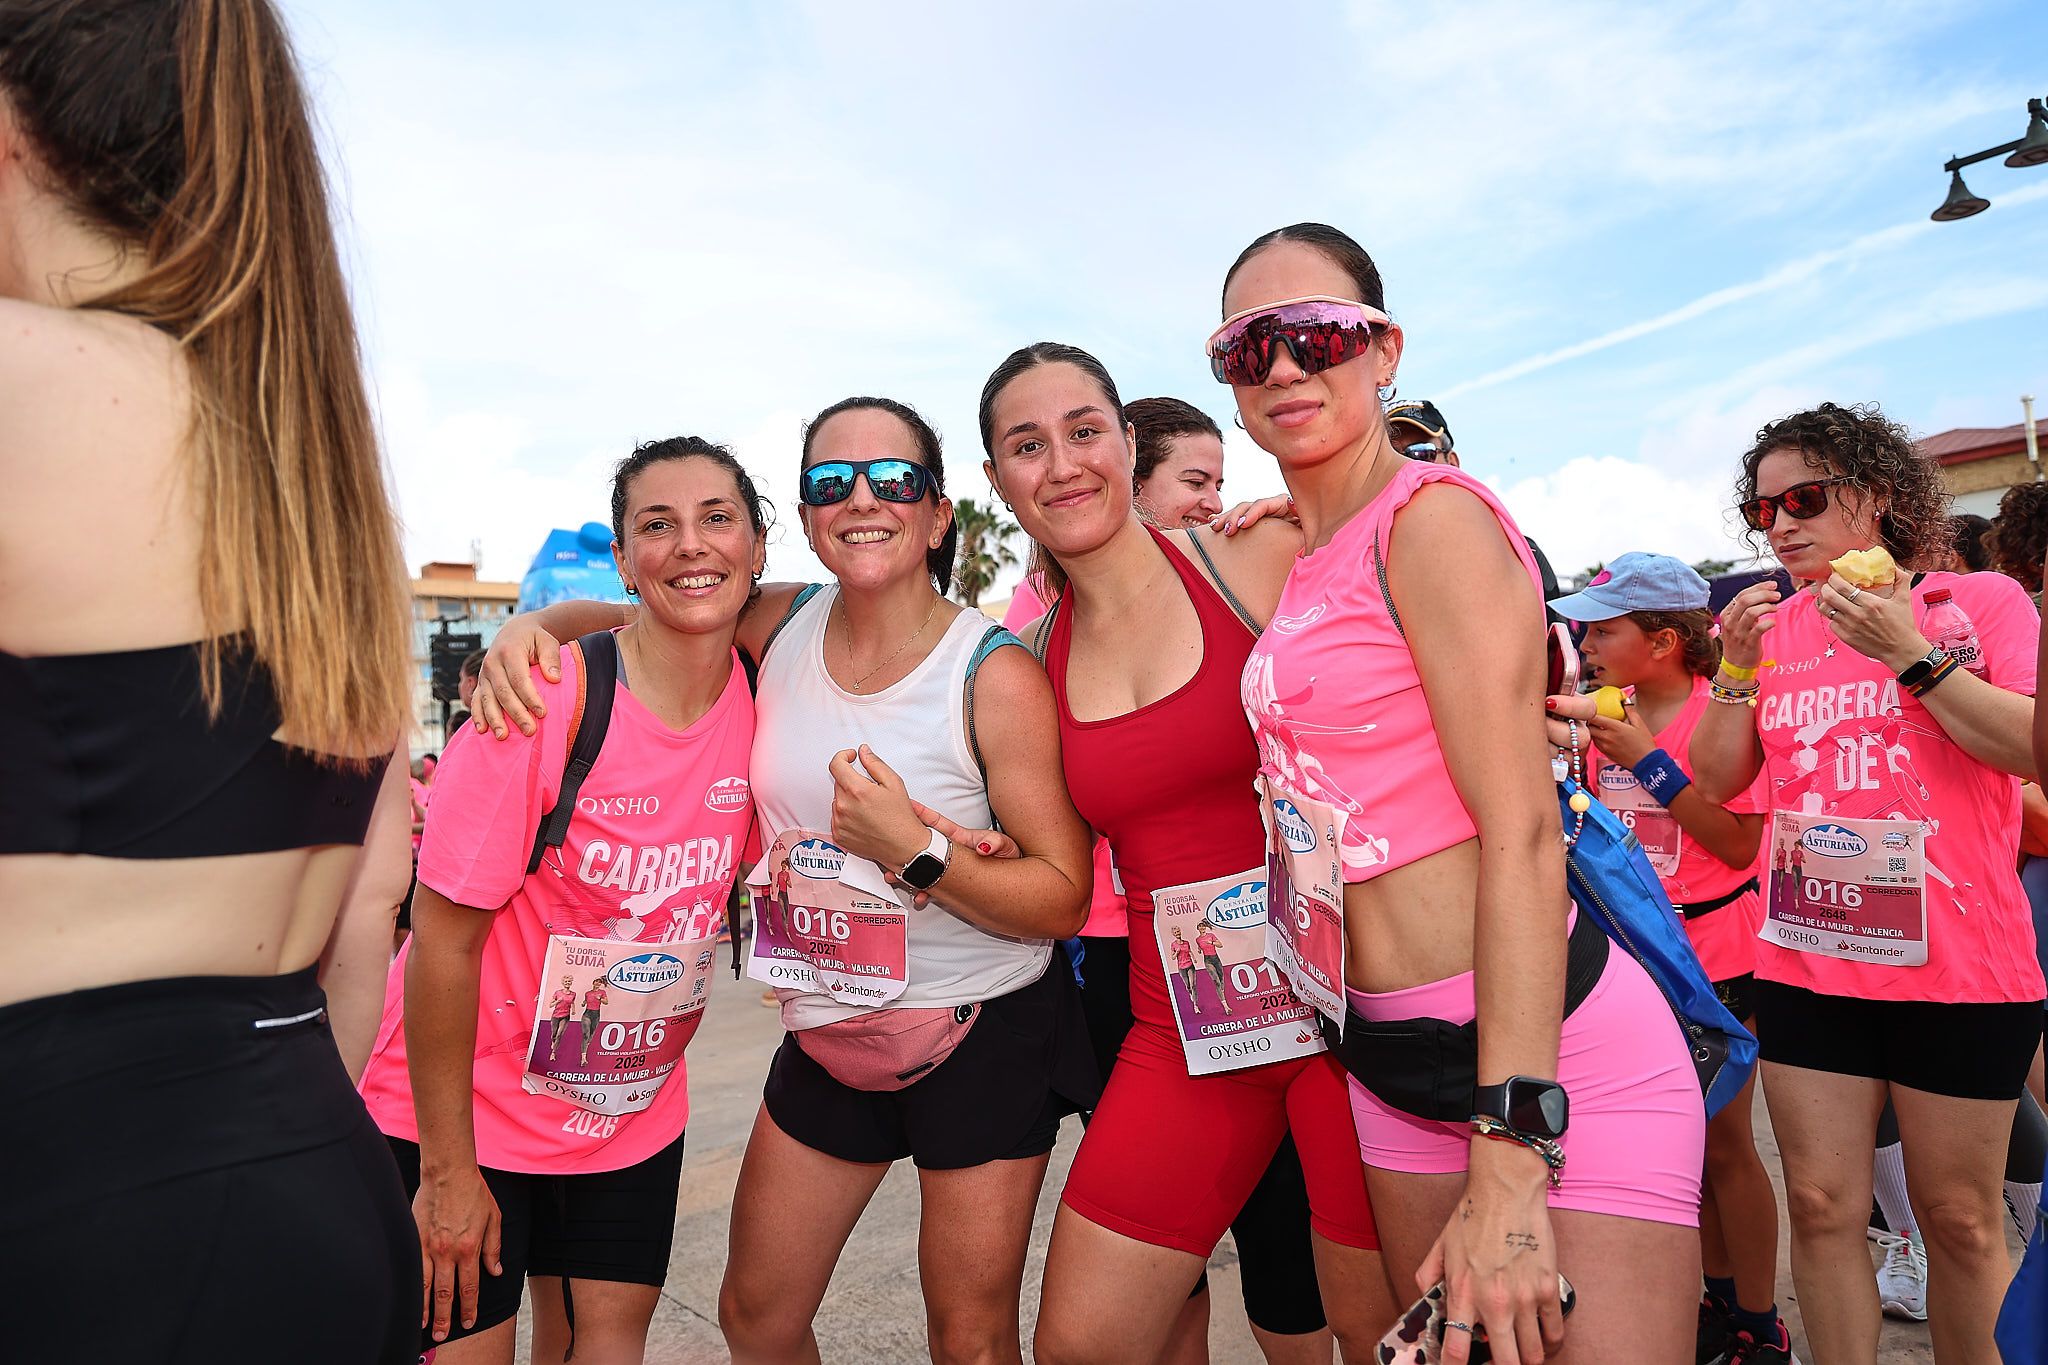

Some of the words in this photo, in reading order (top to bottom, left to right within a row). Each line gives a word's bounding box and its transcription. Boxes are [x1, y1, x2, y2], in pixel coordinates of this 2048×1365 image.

[1761, 678, 1902, 732] CARRERA
[1834, 733, 1880, 791] DE
[578, 796, 660, 816] OYSHO
[1781, 823, 1800, 834] SUMA
[1806, 833, 1862, 852] ASTURIANA
[577, 834, 733, 893] CARRERA
[1164, 898, 1171, 906] TU
[1172, 894, 1198, 905] DORSAL
[1804, 878, 1863, 907] 016
[1866, 887, 1919, 897] CORREDORA
[1166, 904, 1201, 917] SUMA
[1214, 900, 1266, 924] ASTURI
[1223, 897, 1253, 909] CENTRAL
[793, 906, 851, 940] 016
[852, 915, 903, 926] CORREDORA
[1819, 907, 1847, 921] 2648
[1778, 911, 1804, 924] CARRERA
[1806, 917, 1815, 926] DE
[1816, 918, 1826, 928] LA
[1827, 921, 1854, 932] MUJER
[1861, 926, 1904, 937] VALENCIA
[1778, 927, 1819, 945] OYSHO
[565, 946, 576, 954] TU
[576, 947, 608, 957] DORSAL
[809, 941, 838, 956] 2027
[1850, 943, 1905, 957] Santander
[565, 954, 606, 968] SUMA
[820, 958, 846, 970] MUJER
[851, 963, 892, 976] VALENCIA
[613, 966, 678, 983] ASTURIANA
[769, 965, 819, 983] OYSHO
[1230, 961, 1282, 994] 01
[844, 983, 888, 999] Santander
[1259, 991, 1297, 1011] 2028
[1200, 1022, 1245, 1036] CARRERA
[1245, 1018, 1260, 1029] DE
[1262, 1013, 1276, 1024] LA
[1276, 1005, 1313, 1022] MUJER
[600, 1019, 667, 1051] 016
[1208, 1036, 1272, 1060] OYSHO
[614, 1055, 646, 1069] 2029
[546, 1071, 591, 1083] CARRERA
[593, 1072, 606, 1082] DE
[608, 1071, 620, 1082] LA
[622, 1069, 650, 1082] MUJER
[545, 1081, 607, 1105] OYSHO
[561, 1110, 619, 1139] 2026
